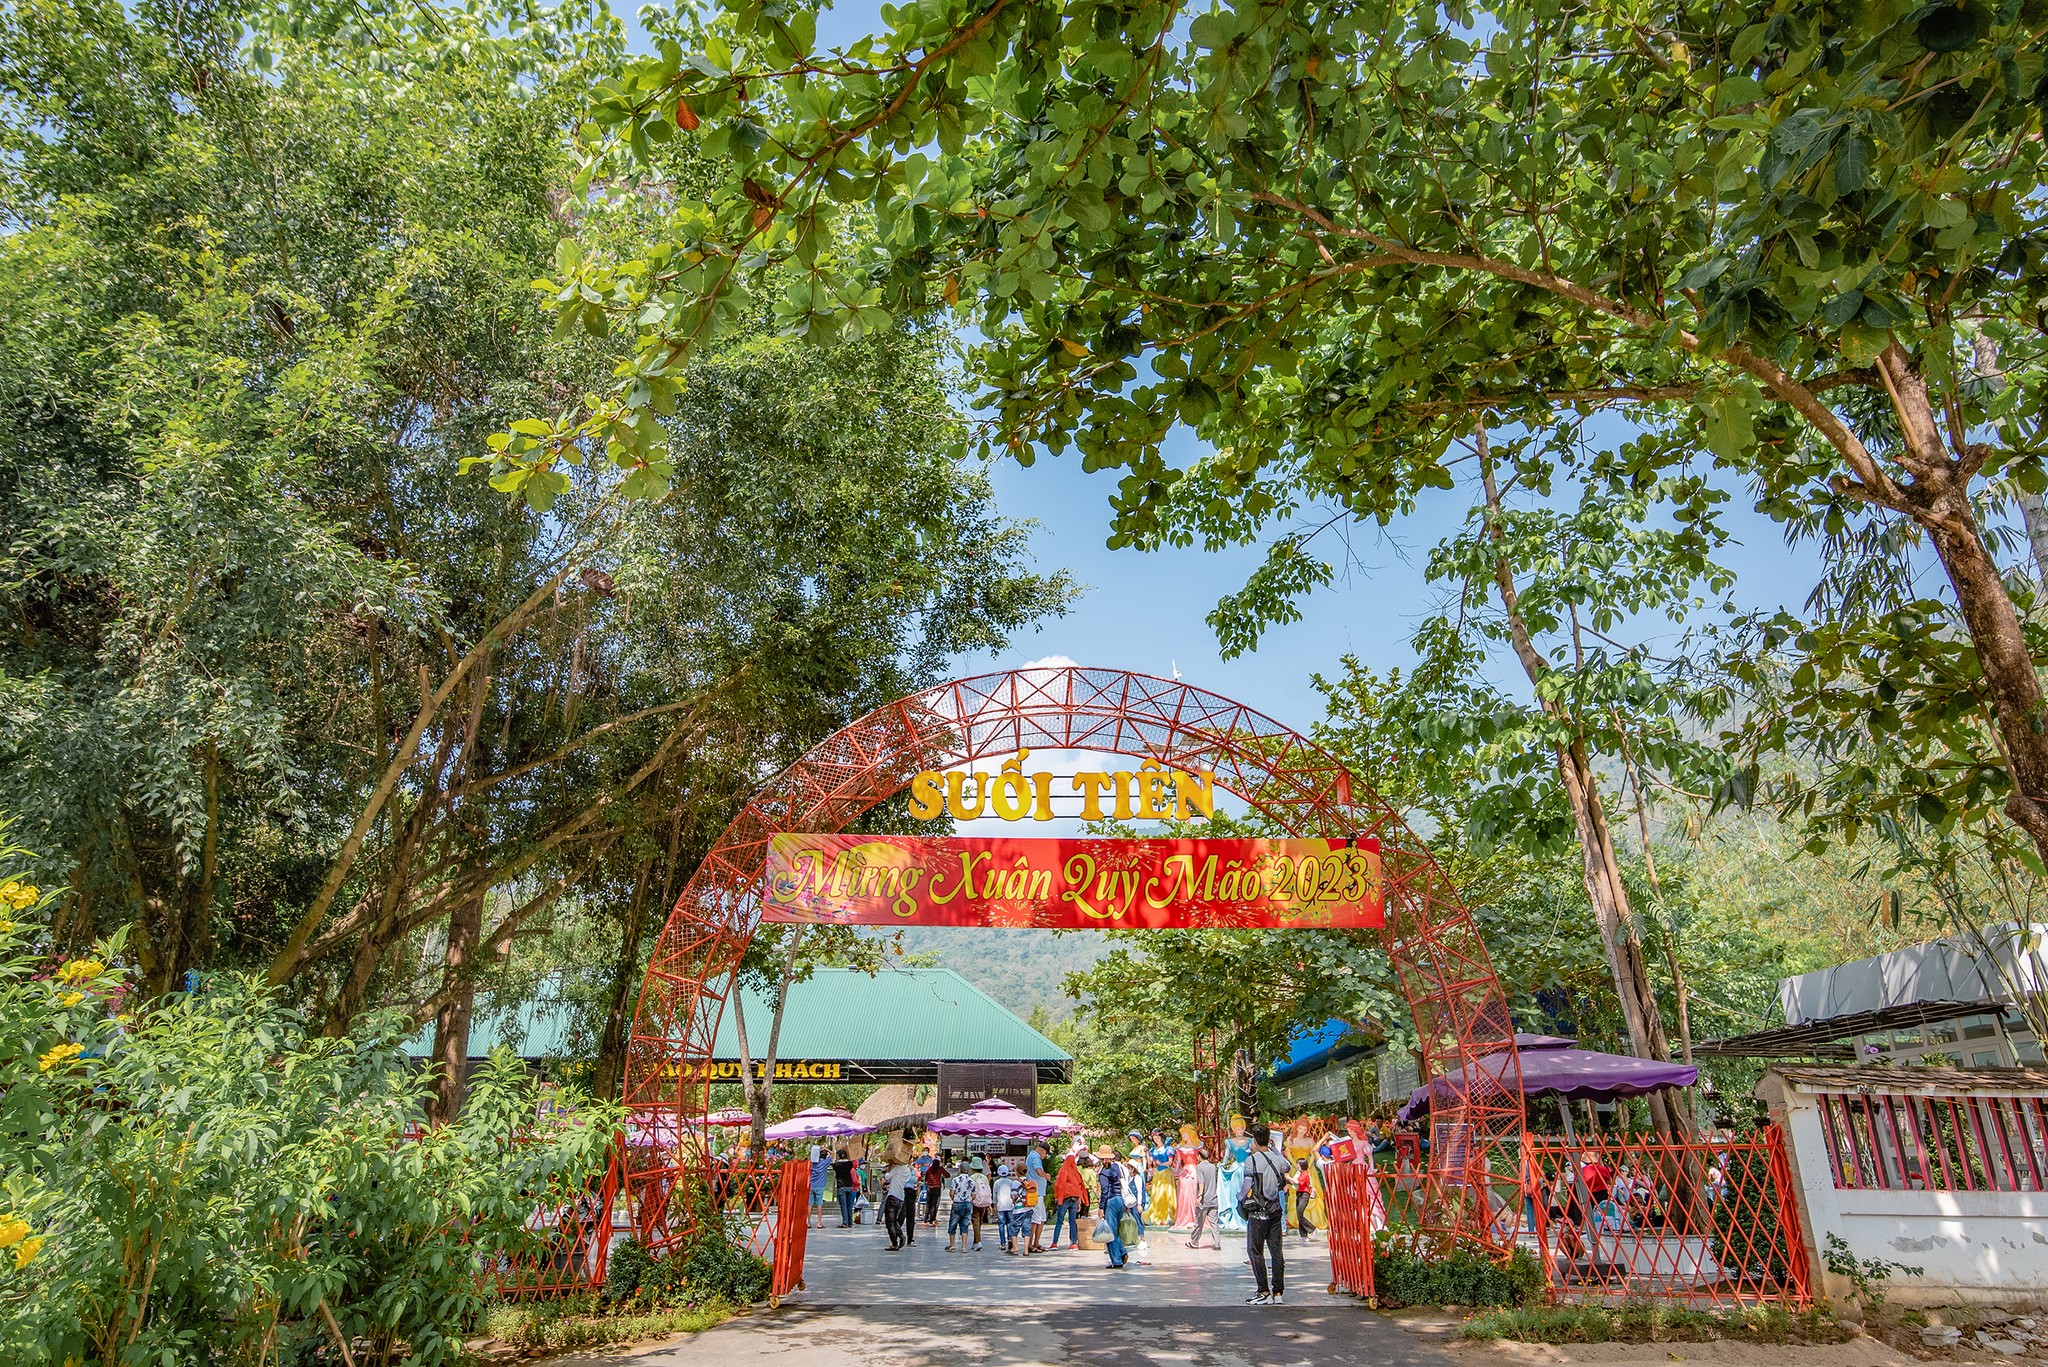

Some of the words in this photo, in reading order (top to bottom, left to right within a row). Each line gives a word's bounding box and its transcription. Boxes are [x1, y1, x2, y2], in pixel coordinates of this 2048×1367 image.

[908, 748, 1055, 821] SUỐI
[1072, 757, 1217, 820] TIÊN
[772, 849, 924, 917] Mừng
[929, 850, 1053, 904] Xuân
[1061, 853, 1141, 920] Quý
[1145, 854, 1261, 908] Mão
[1268, 854, 1369, 902] 2023
